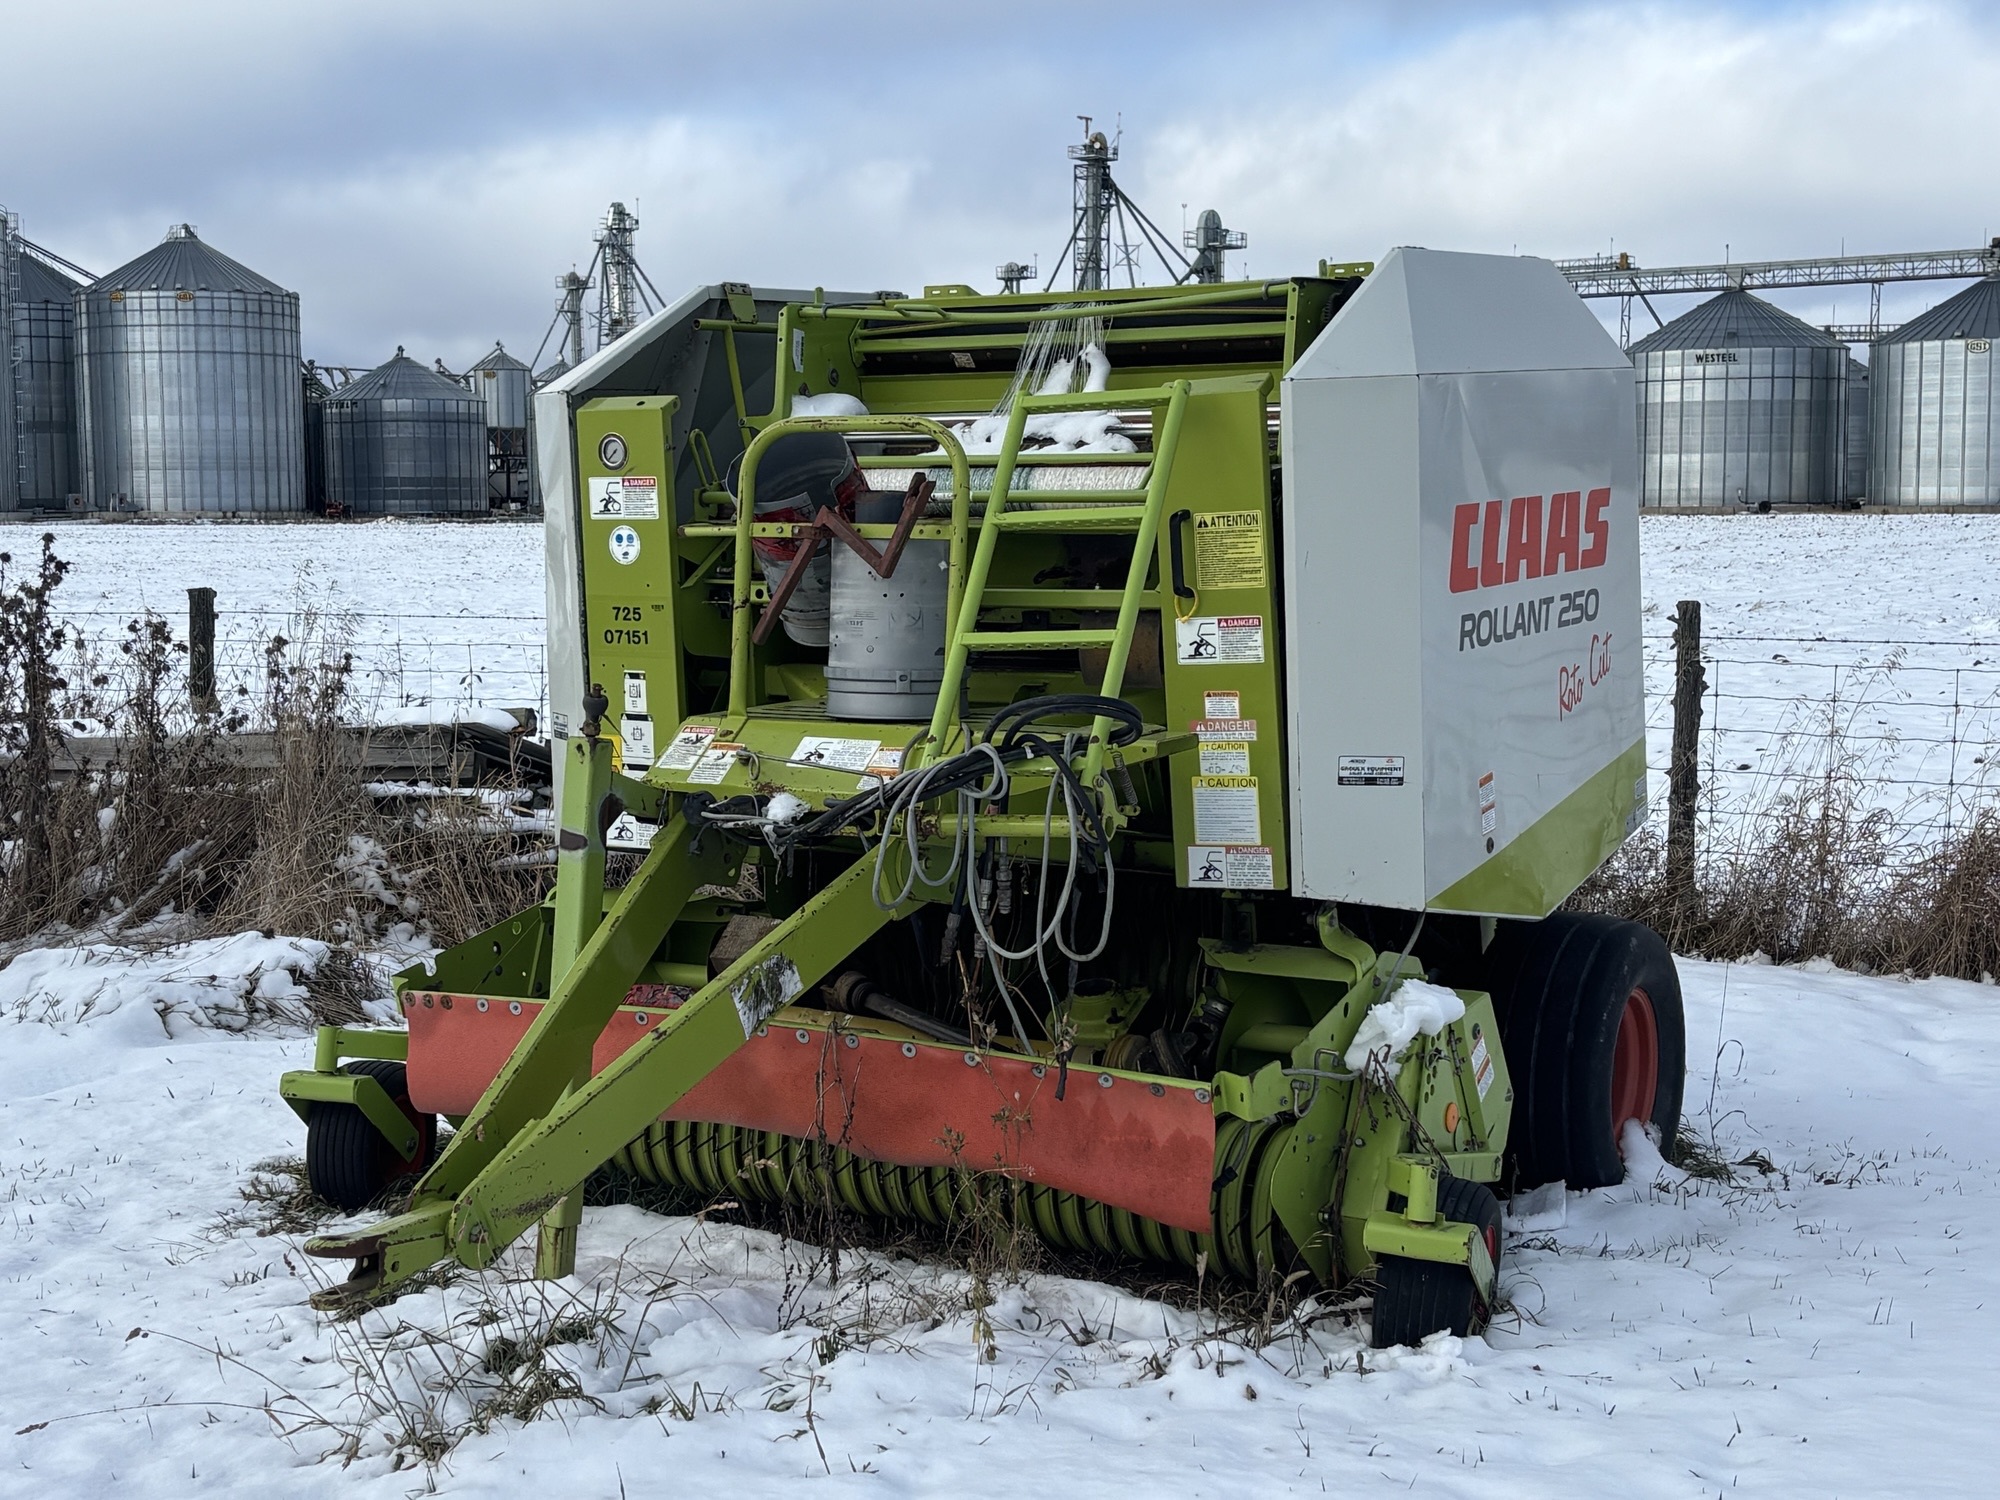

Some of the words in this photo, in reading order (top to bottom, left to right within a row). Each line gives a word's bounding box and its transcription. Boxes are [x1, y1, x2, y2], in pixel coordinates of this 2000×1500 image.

[1970, 342, 1988, 351] GSI
[1695, 353, 1738, 363] WESTEEL
[1210, 513, 1259, 527] ATTENTION
[1449, 487, 1611, 594] CLAAS
[612, 606, 642, 621] 725
[1228, 618, 1260, 626] DANGER
[1459, 596, 1555, 652] ROLLANT
[1557, 588, 1600, 629] 250
[604, 629, 649, 645] 07151
[1559, 663, 1585, 722] Roto
[1589, 631, 1613, 687] Cut
[1207, 721, 1251, 731] DANGER
[1211, 743, 1245, 751] CAUTION
[1208, 778, 1257, 788] CAUTION
[1238, 846, 1270, 854] DANGER
